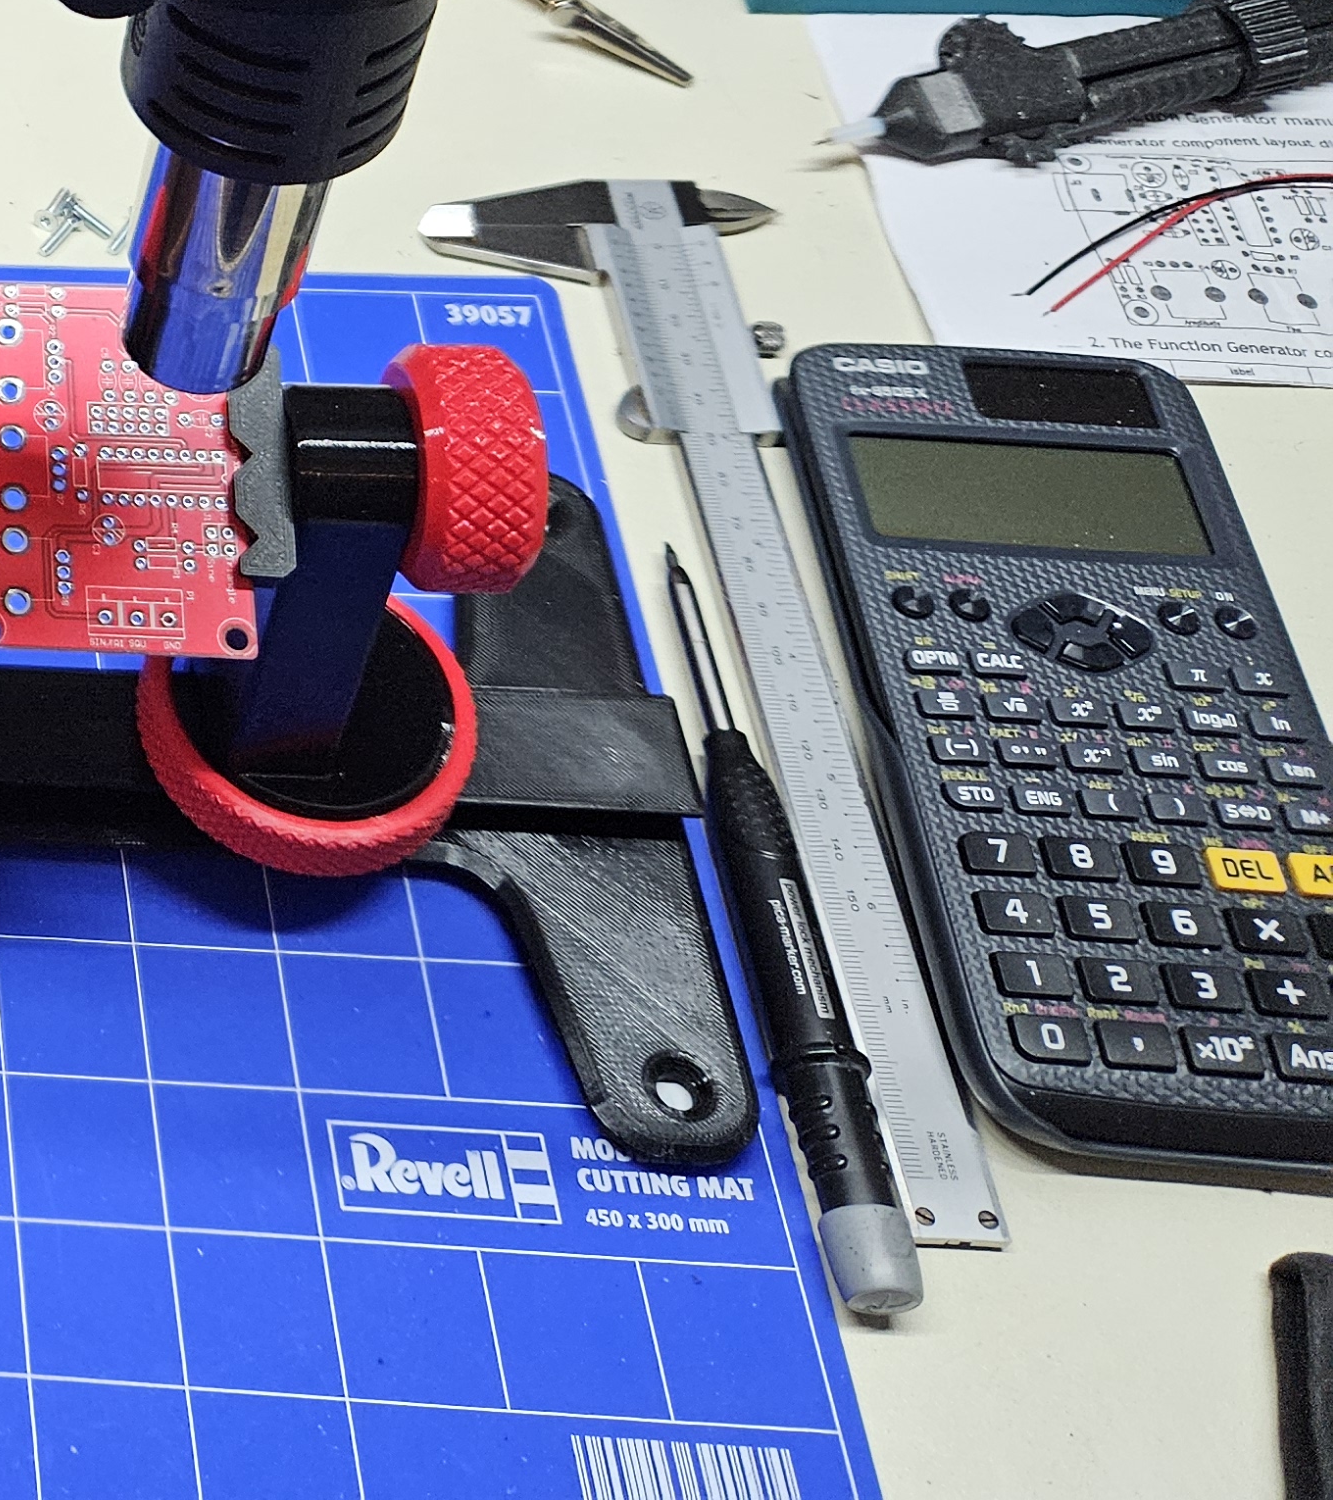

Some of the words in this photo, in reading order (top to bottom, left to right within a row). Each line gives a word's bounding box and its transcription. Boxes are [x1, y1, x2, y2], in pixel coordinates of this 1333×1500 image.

[1173, 136, 1261, 149] component
[1262, 136, 1315, 149] layout
[444, 303, 532, 327] 39057
[1087, 336, 1105, 348] 2.
[1112, 337, 1143, 350] The
[1147, 338, 1223, 354] Function
[1227, 342, 1308, 358] Generator
[832, 356, 930, 376] CASIO
[1229, 364, 1256, 377] label
[1133, 586, 1165, 597] MENU
[1169, 588, 1203, 600] SETUP
[1214, 591, 1235, 602] ON
[757, 601, 768, 618] 90
[163, 640, 182, 651] GND
[771, 646, 783, 666] 100
[911, 649, 960, 667] OPTN
[976, 653, 1024, 670] CALC
[785, 692, 798, 712] 110
[1270, 716, 1292, 732] ln
[800, 739, 813, 761] 120
[1150, 752, 1180, 769] sin
[940, 769, 990, 783] RECALL
[1216, 758, 1249, 774] cos
[1283, 761, 1317, 779] tan
[814, 787, 829, 811] 130
[957, 785, 995, 802] STO
[1024, 789, 1064, 807] ENG
[1131, 830, 1171, 844] RESET
[830, 837, 844, 862] 140
[986, 837, 1009, 864] 7
[1068, 843, 1095, 870] 8
[1150, 848, 1178, 875] 9
[1221, 857, 1274, 881] DEL
[845, 888, 860, 913] 150
[865, 901, 877, 911] 6
[1004, 898, 1030, 924] 4
[1087, 903, 1114, 930] 5
[1170, 909, 1199, 936] 6
[766, 898, 807, 996] pica-marker.com
[785, 881, 803, 920] power
[795, 917, 811, 946] lock
[803, 944, 832, 1016] mechanism
[1025, 959, 1042, 987] 1
[1105, 964, 1133, 992] 2
[1191, 971, 1218, 1000] 3
[1002, 1001, 1029, 1015] Rnd
[1040, 1023, 1066, 1050] 0
[349, 1132, 506, 1200] Revell
[925, 1129, 949, 1181] HARDENED
[936, 1131, 960, 1182] STAINLESS
[576, 1167, 690, 1197] CUTTING
[696, 1175, 755, 1202] MAT
[585, 1208, 623, 1229] 450
[627, 1214, 642, 1229] x
[646, 1211, 684, 1232] 300
[687, 1216, 730, 1235] mm
